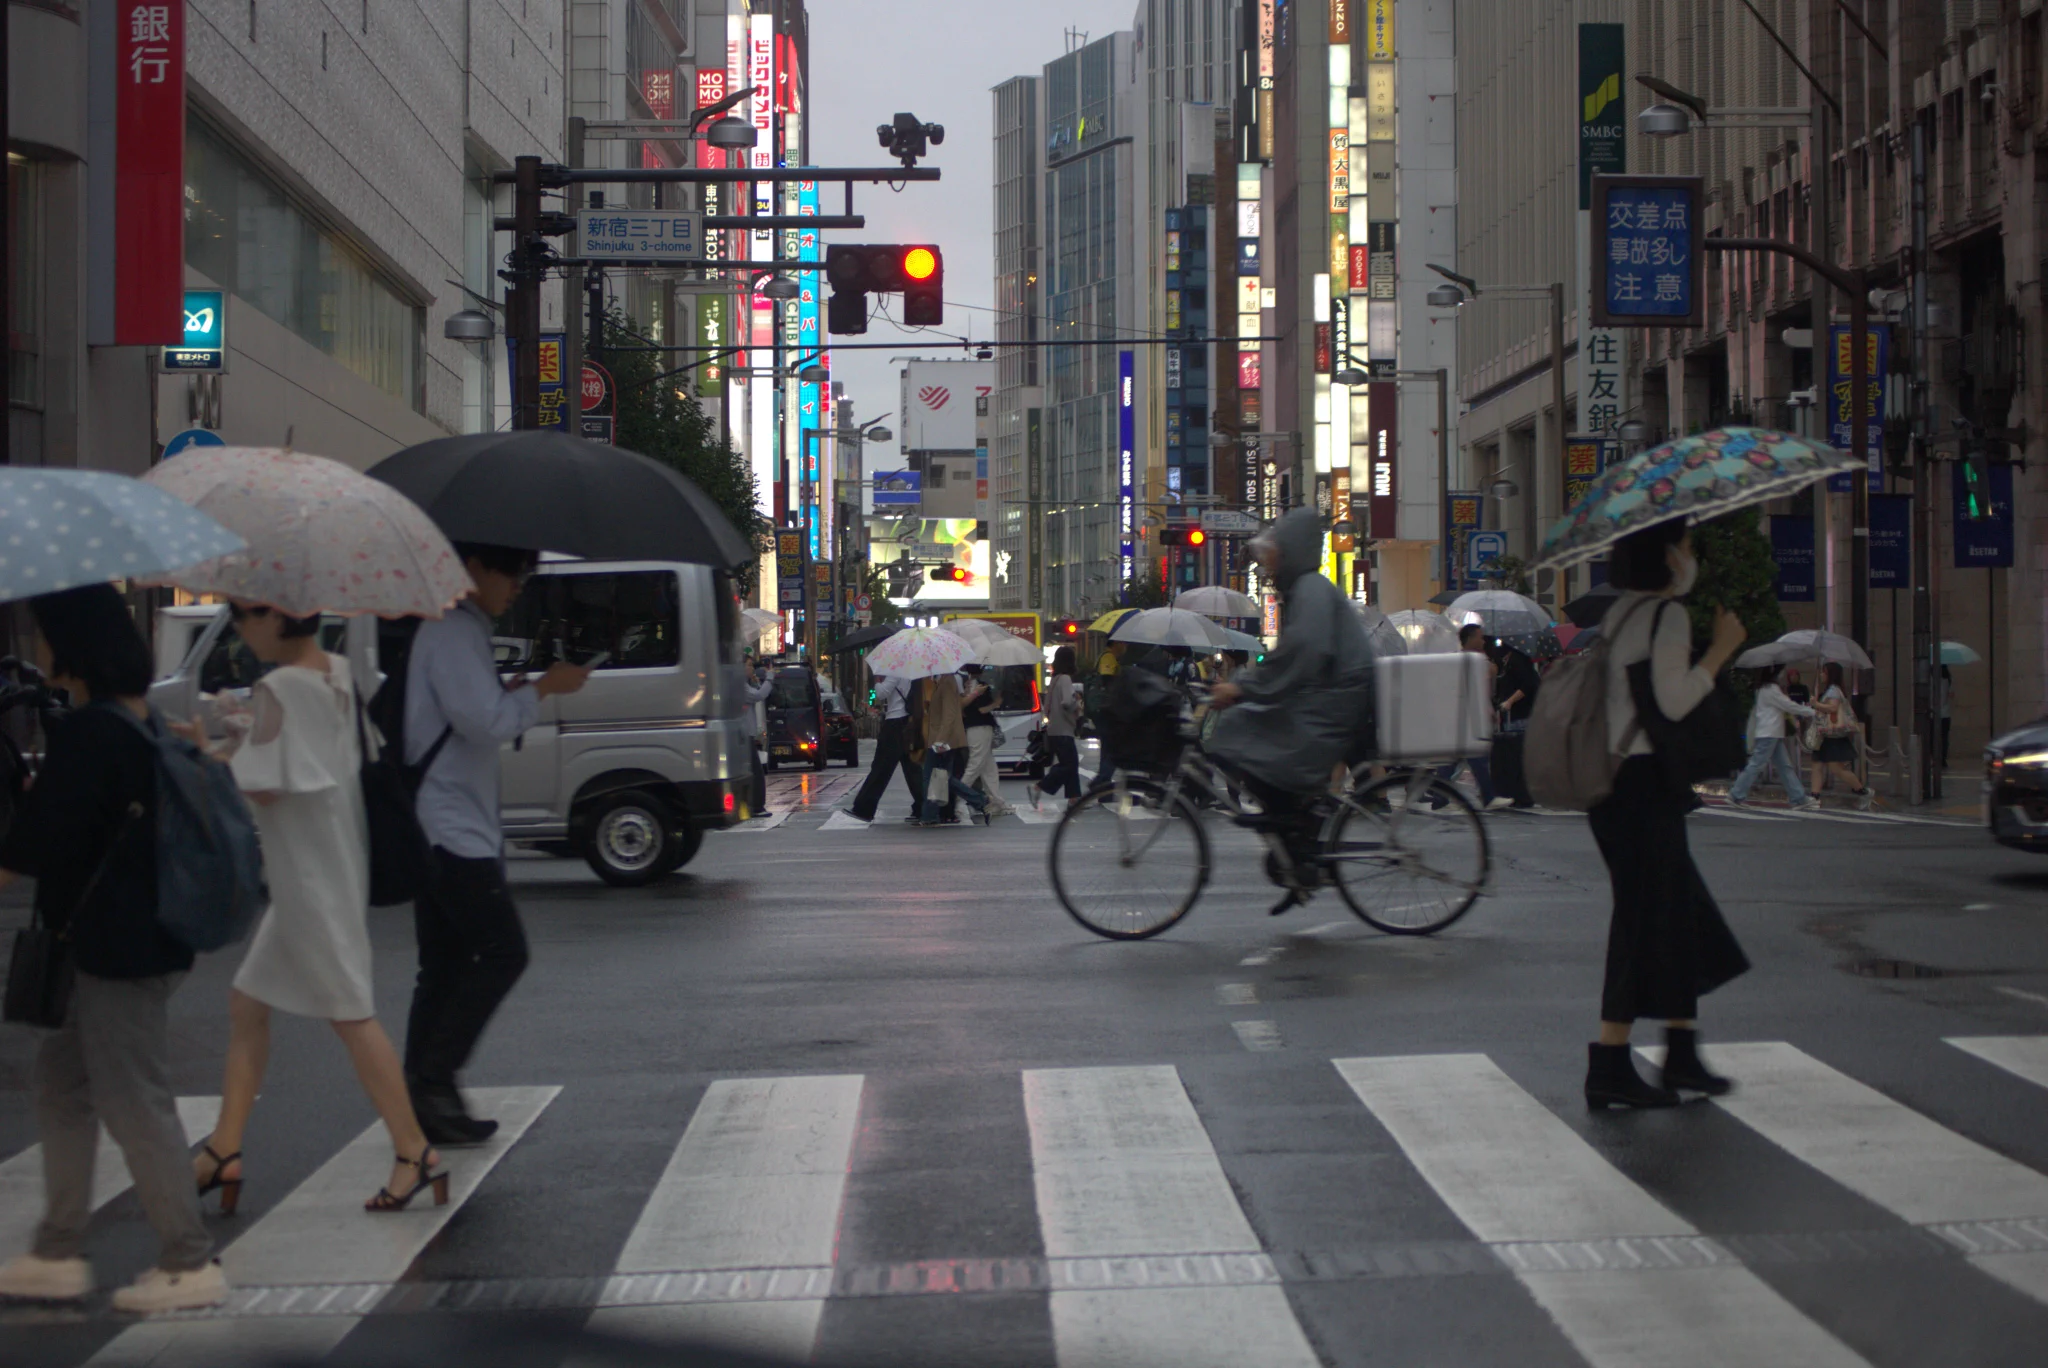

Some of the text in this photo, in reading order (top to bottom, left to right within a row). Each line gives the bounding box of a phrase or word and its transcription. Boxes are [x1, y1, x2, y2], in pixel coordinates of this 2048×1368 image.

[131, 6, 169, 83] 銀行
[699, 73, 722, 84] MO
[699, 89, 722, 99] MO
[1583, 126, 1621, 137] SMBC
[588, 217, 691, 238] 新宿三丁目
[1610, 201, 1686, 230] 交差点
[587, 240, 692, 253] Shinjuku 3-chome
[1611, 237, 1685, 265] 事故多し
[1614, 271, 1681, 301] 注意
[1569, 446, 1594, 473] 薬
[1375, 463, 1390, 496] MUJI
